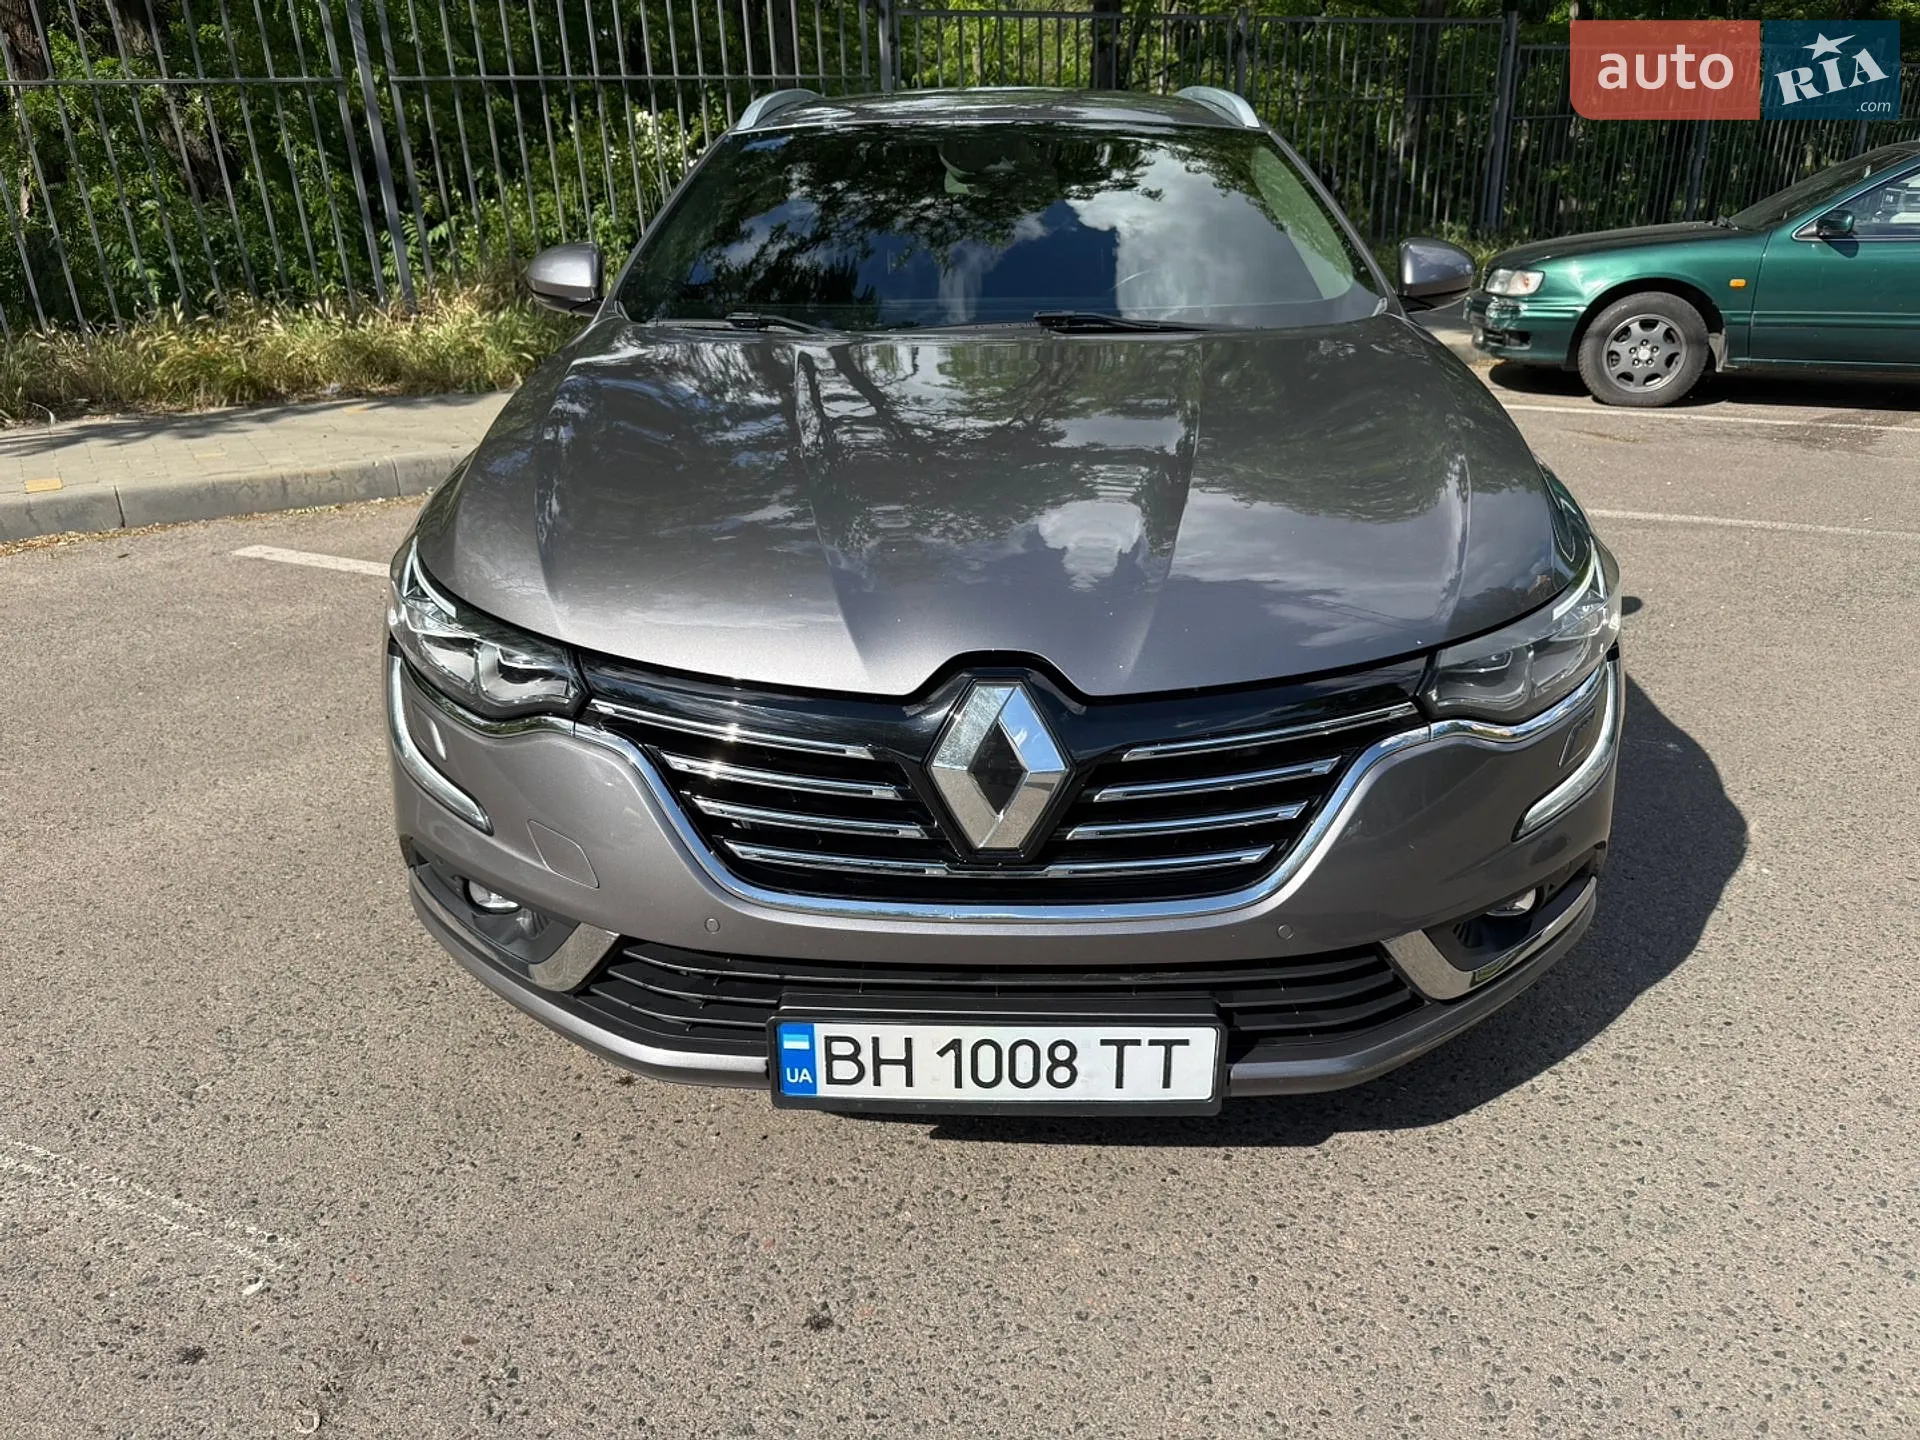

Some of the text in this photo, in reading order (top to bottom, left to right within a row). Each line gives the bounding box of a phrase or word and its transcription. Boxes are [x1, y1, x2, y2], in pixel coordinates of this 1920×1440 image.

[786, 1067, 813, 1084] UA
[823, 1035, 1190, 1090] BH 1008 TT
